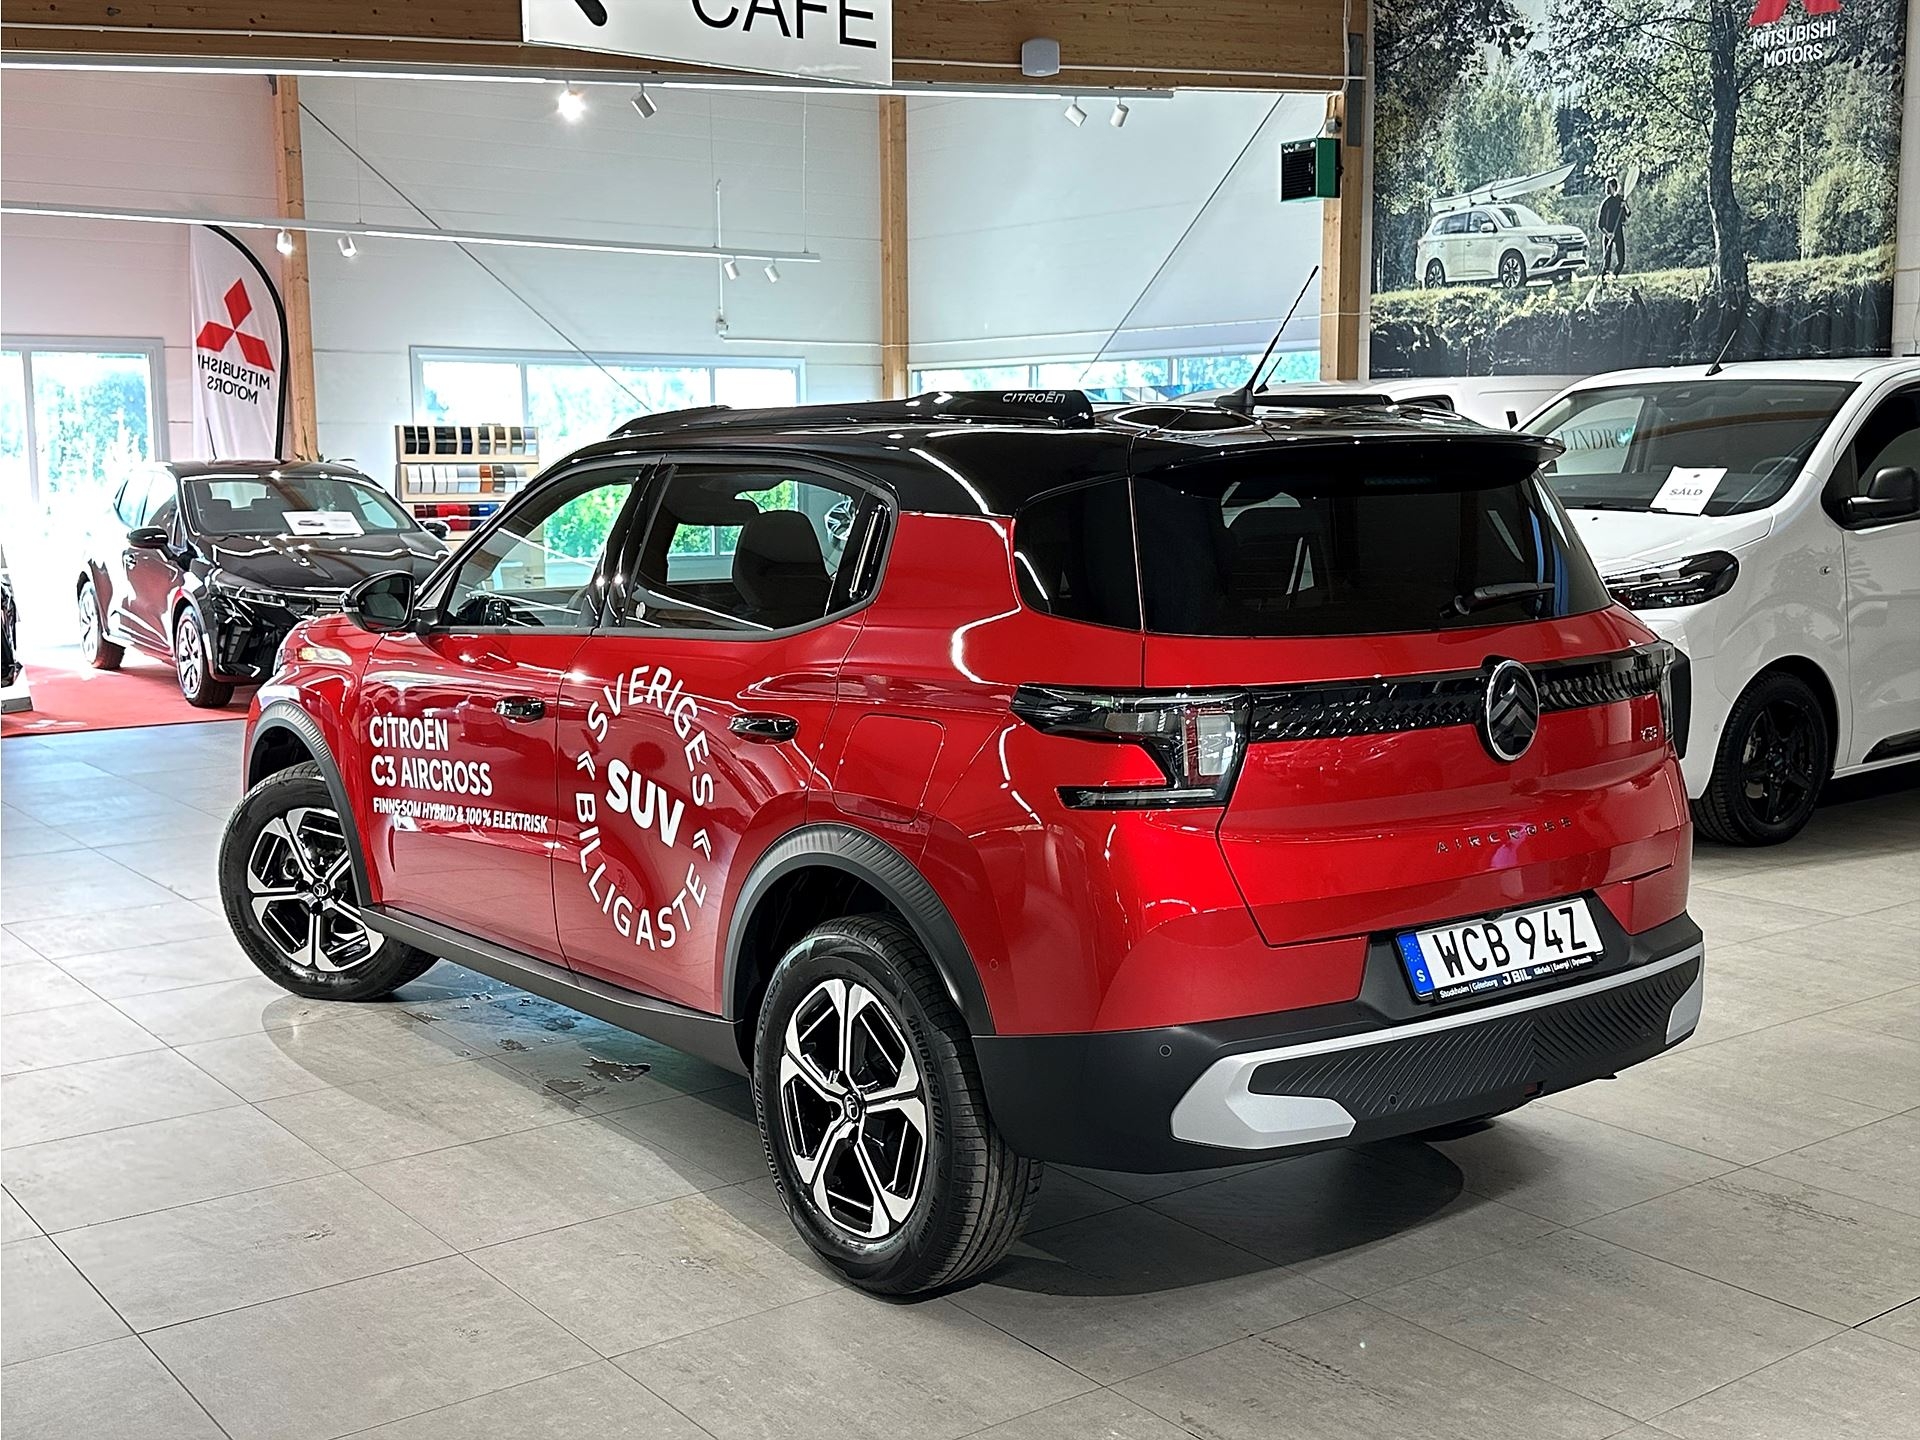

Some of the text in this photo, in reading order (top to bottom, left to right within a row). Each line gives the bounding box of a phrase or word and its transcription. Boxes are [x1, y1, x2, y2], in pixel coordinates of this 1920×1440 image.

[1751, 19, 1837, 50] MITSUBISHI
[1763, 43, 1823, 69] MOTORS
[369, 712, 449, 751] CITROËN
[587, 665, 714, 807] SVERIGES
[371, 754, 493, 797] C3 AIRCROSS
[373, 797, 399, 815] FINNS
[399, 799, 421, 818] SOM
[421, 801, 456, 823] HYBRID
[456, 806, 465, 824] &
[492, 810, 549, 834] ELEKTRISK
[606, 758, 685, 848] SUV
[1436, 816, 1573, 853] AIRCROSS
[575, 792, 707, 951] BILLIGASTE
[1416, 906, 1588, 983] S WCB 94Z
[1439, 985, 1470, 999] Stockholm
[1512, 968, 1532, 984] BIL
[906, 1016, 945, 1143] BRIDGESTONE
[755, 1075, 785, 1194] BRIDGESTONE
